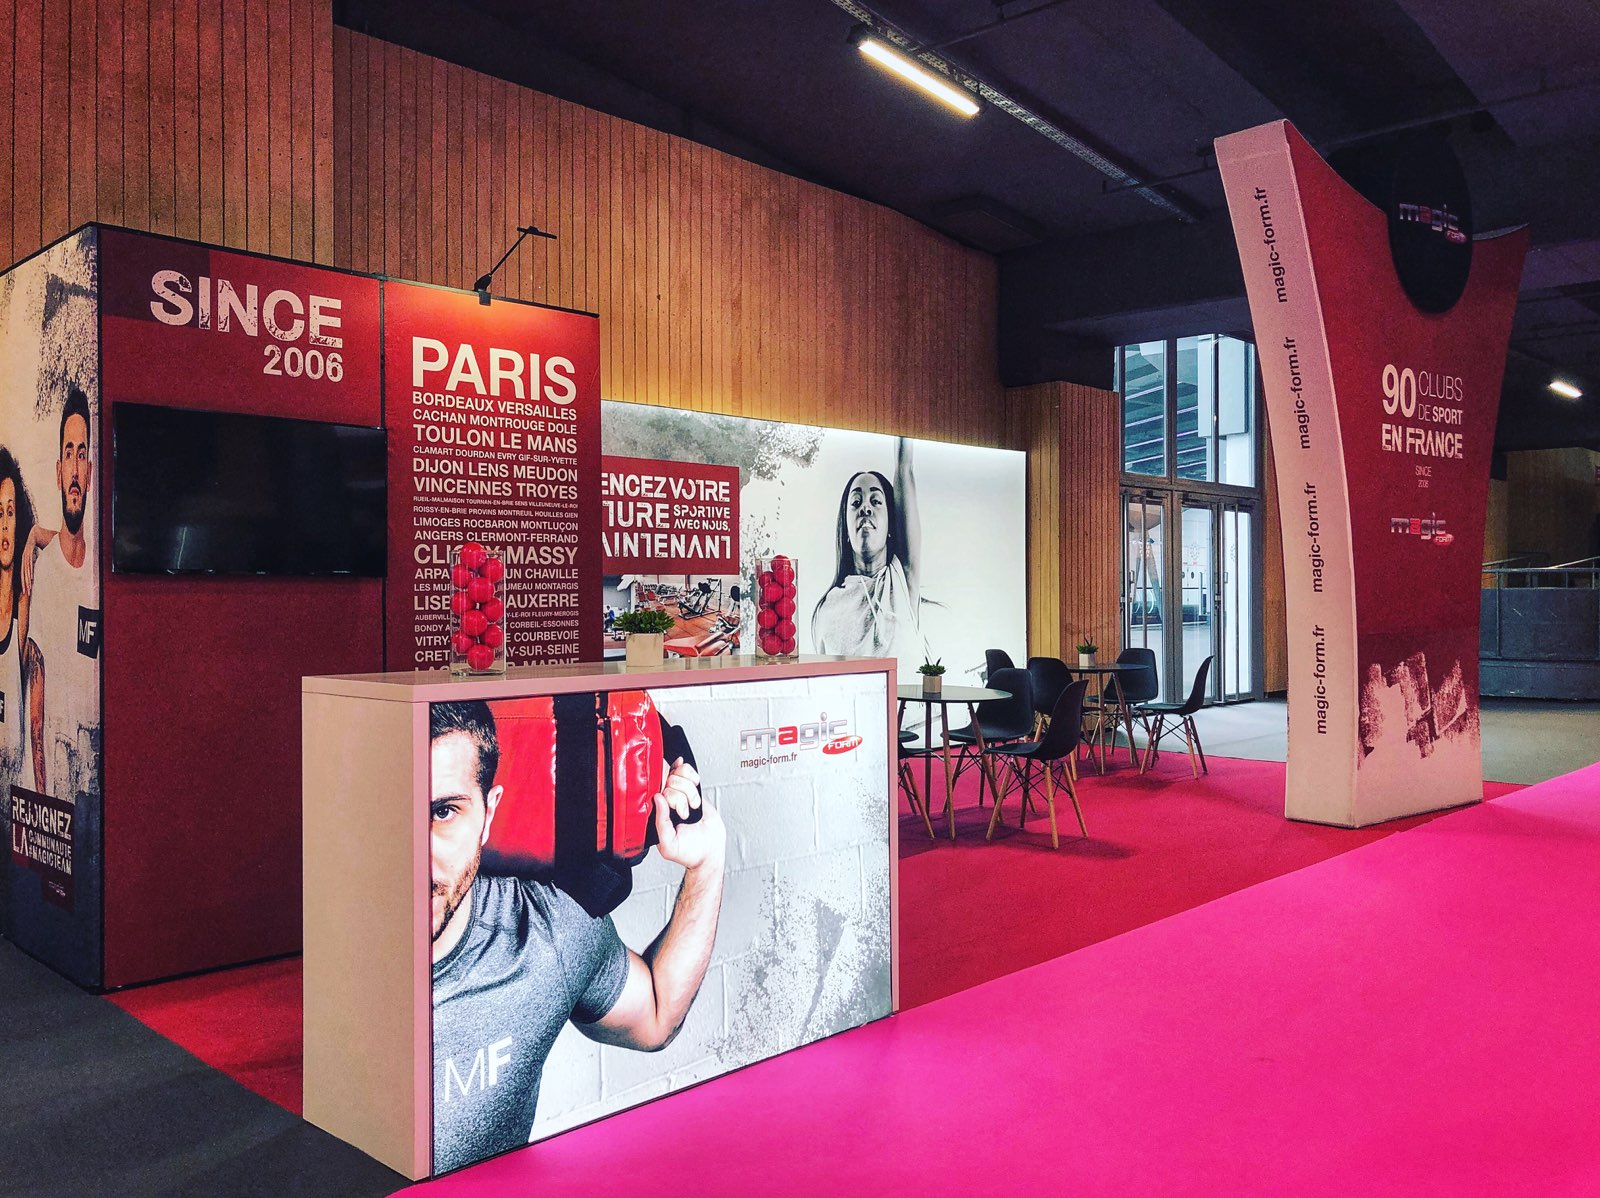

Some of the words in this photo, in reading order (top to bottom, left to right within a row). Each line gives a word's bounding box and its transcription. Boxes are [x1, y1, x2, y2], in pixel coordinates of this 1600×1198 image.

[1254, 187, 1287, 302] magic-form.fr
[150, 269, 343, 349] SINCE
[263, 344, 344, 383] 2006
[412, 336, 577, 405] PARIS
[1283, 337, 1311, 449] magic-form.fr
[1381, 363, 1417, 418] 90
[1418, 370, 1463, 402] CLUBS
[413, 391, 494, 412] BORDEAUX
[498, 401, 577, 421] VERSAILLES
[1418, 403, 1431, 422] DE
[1432, 407, 1463, 425] SPORT
[413, 408, 466, 424] CACHAN
[469, 415, 545, 432] MONTROUGE
[548, 422, 577, 435] DOLE
[413, 423, 495, 447] TOULON
[500, 431, 522, 449] LE
[527, 434, 578, 454] MANS
[1381, 423, 1402, 452] EN
[1406, 427, 1463, 459] FRANCE
[413, 445, 453, 456] CLAMART
[455, 449, 496, 459] DOURDAN
[497, 452, 516, 461] EVRY
[518, 454, 578, 466] GIF-SUR-YVETTE
[413, 458, 463, 476] DIJON
[468, 462, 509, 478] LENS
[513, 465, 578, 482] MEUDON
[1415, 465, 1432, 477] SINCE
[413, 476, 512, 497] VINCENNES
[516, 482, 578, 500] TROYES
[601, 472, 667, 498] ENCEZ
[668, 477, 730, 502] VOTRE
[413, 505, 467, 515] ROISSY-EN-BRIE
[468, 508, 497, 516] PROVINS
[497, 509, 534, 517] MONTREUIL
[534, 510, 564, 518] HOUILLES
[413, 517, 461, 528] LIMOGES
[463, 518, 519, 529] ROCBARON
[520, 521, 578, 533] MONTLUÇON
[602, 500, 670, 529] TURE
[673, 504, 730, 519] SPORTIVE
[414, 530, 464, 541] ANGERS
[466, 531, 578, 544] CLERMONT-FERRAND
[673, 519, 700, 530] AVEC
[702, 520, 731, 532] NOUS,
[1304, 482, 1325, 593] magic-form.fr
[1391, 511, 1446, 540] magic
[506, 546, 578, 565] MASSY
[601, 531, 731, 559] AINTENANT
[413, 583, 430, 592] LES
[534, 582, 579, 590] MONTARGIS
[414, 568, 450, 580] ARPA
[525, 568, 579, 579] CHAVILLE
[506, 593, 579, 609] AUXERRE
[414, 613, 450, 621] AUBERVILL
[414, 624, 443, 632] BONDY
[509, 619, 579, 629] CORBEIL-ESSONNES
[79, 618, 97, 644] MF
[513, 630, 580, 642] COURBEVOIE
[414, 650, 450, 663] CRET
[1313, 624, 1330, 735] magic-form.fr
[740, 711, 848, 751] magic
[740, 752, 797, 769] magic-form.fr
[12, 796, 72, 841] REJOIGNEZ
[12, 823, 29, 857] LA
[444, 1035, 513, 1103] MF
